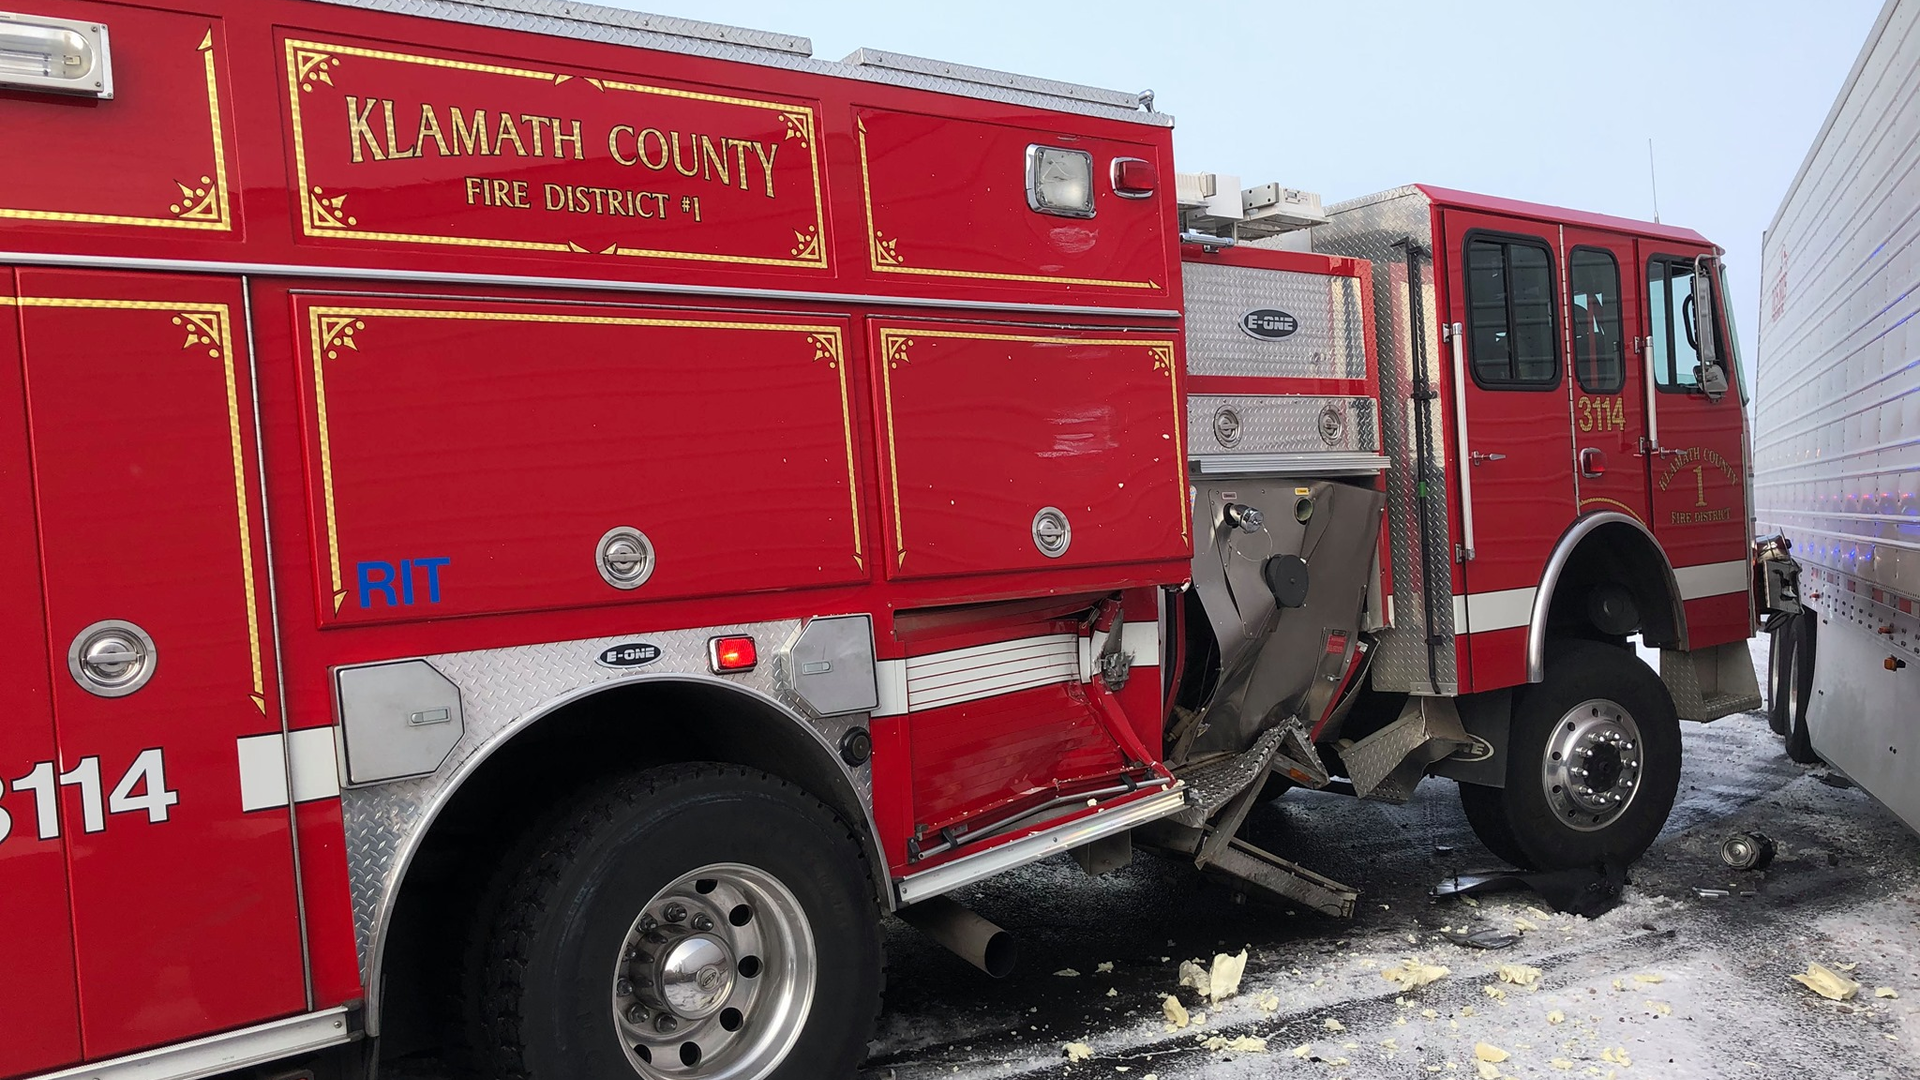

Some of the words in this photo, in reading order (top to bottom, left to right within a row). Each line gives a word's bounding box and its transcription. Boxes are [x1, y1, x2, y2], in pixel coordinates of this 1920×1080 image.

[345, 95, 585, 164] KLAMATH
[606, 122, 780, 199] COUNTY
[464, 175, 532, 210] FIRE
[543, 182, 671, 220] DISTRICT
[680, 196, 702, 223] #1
[1247, 315, 1294, 331] E-ONE
[1578, 396, 1626, 432] 3114
[1658, 446, 1701, 492] KLAMATH
[1702, 447, 1739, 487] COUNTY
[1692, 465, 1708, 507] 1
[1671, 511, 1692, 524] FIRE
[1694, 507, 1731, 522] DISTRICT
[356, 556, 452, 609] RIT
[606, 647, 655, 662] E-ONE
